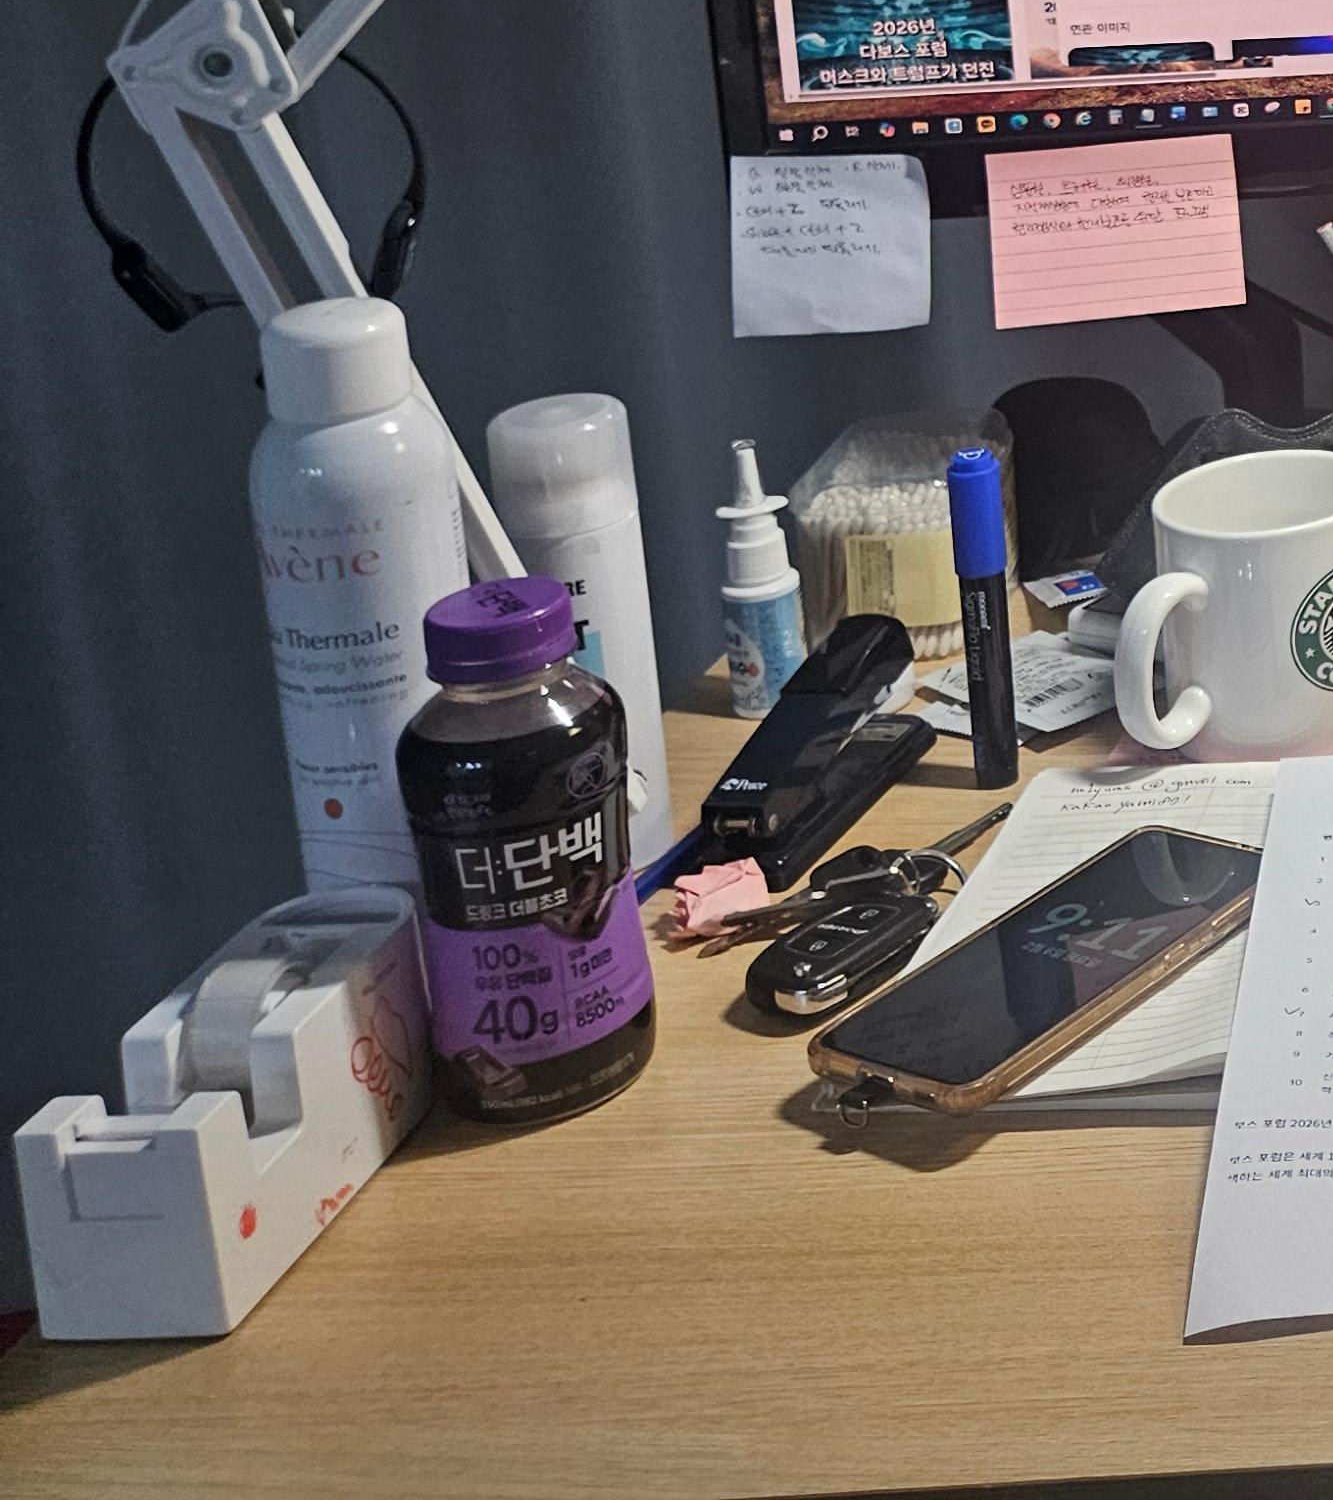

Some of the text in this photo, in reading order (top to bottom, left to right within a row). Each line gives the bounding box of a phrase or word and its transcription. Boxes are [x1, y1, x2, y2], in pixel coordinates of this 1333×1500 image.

[1097, 21, 1130, 33] 이미지
[860, 40, 947, 60] 다보스 포럼
[820, 61, 994, 85] 머스크와 트럼프가 던진
[285, 621, 400, 650] Thermale
[455, 812, 602, 894] 더:단백
[472, 943, 538, 971] 100%
[1300, 1151, 1323, 1161] 세계
